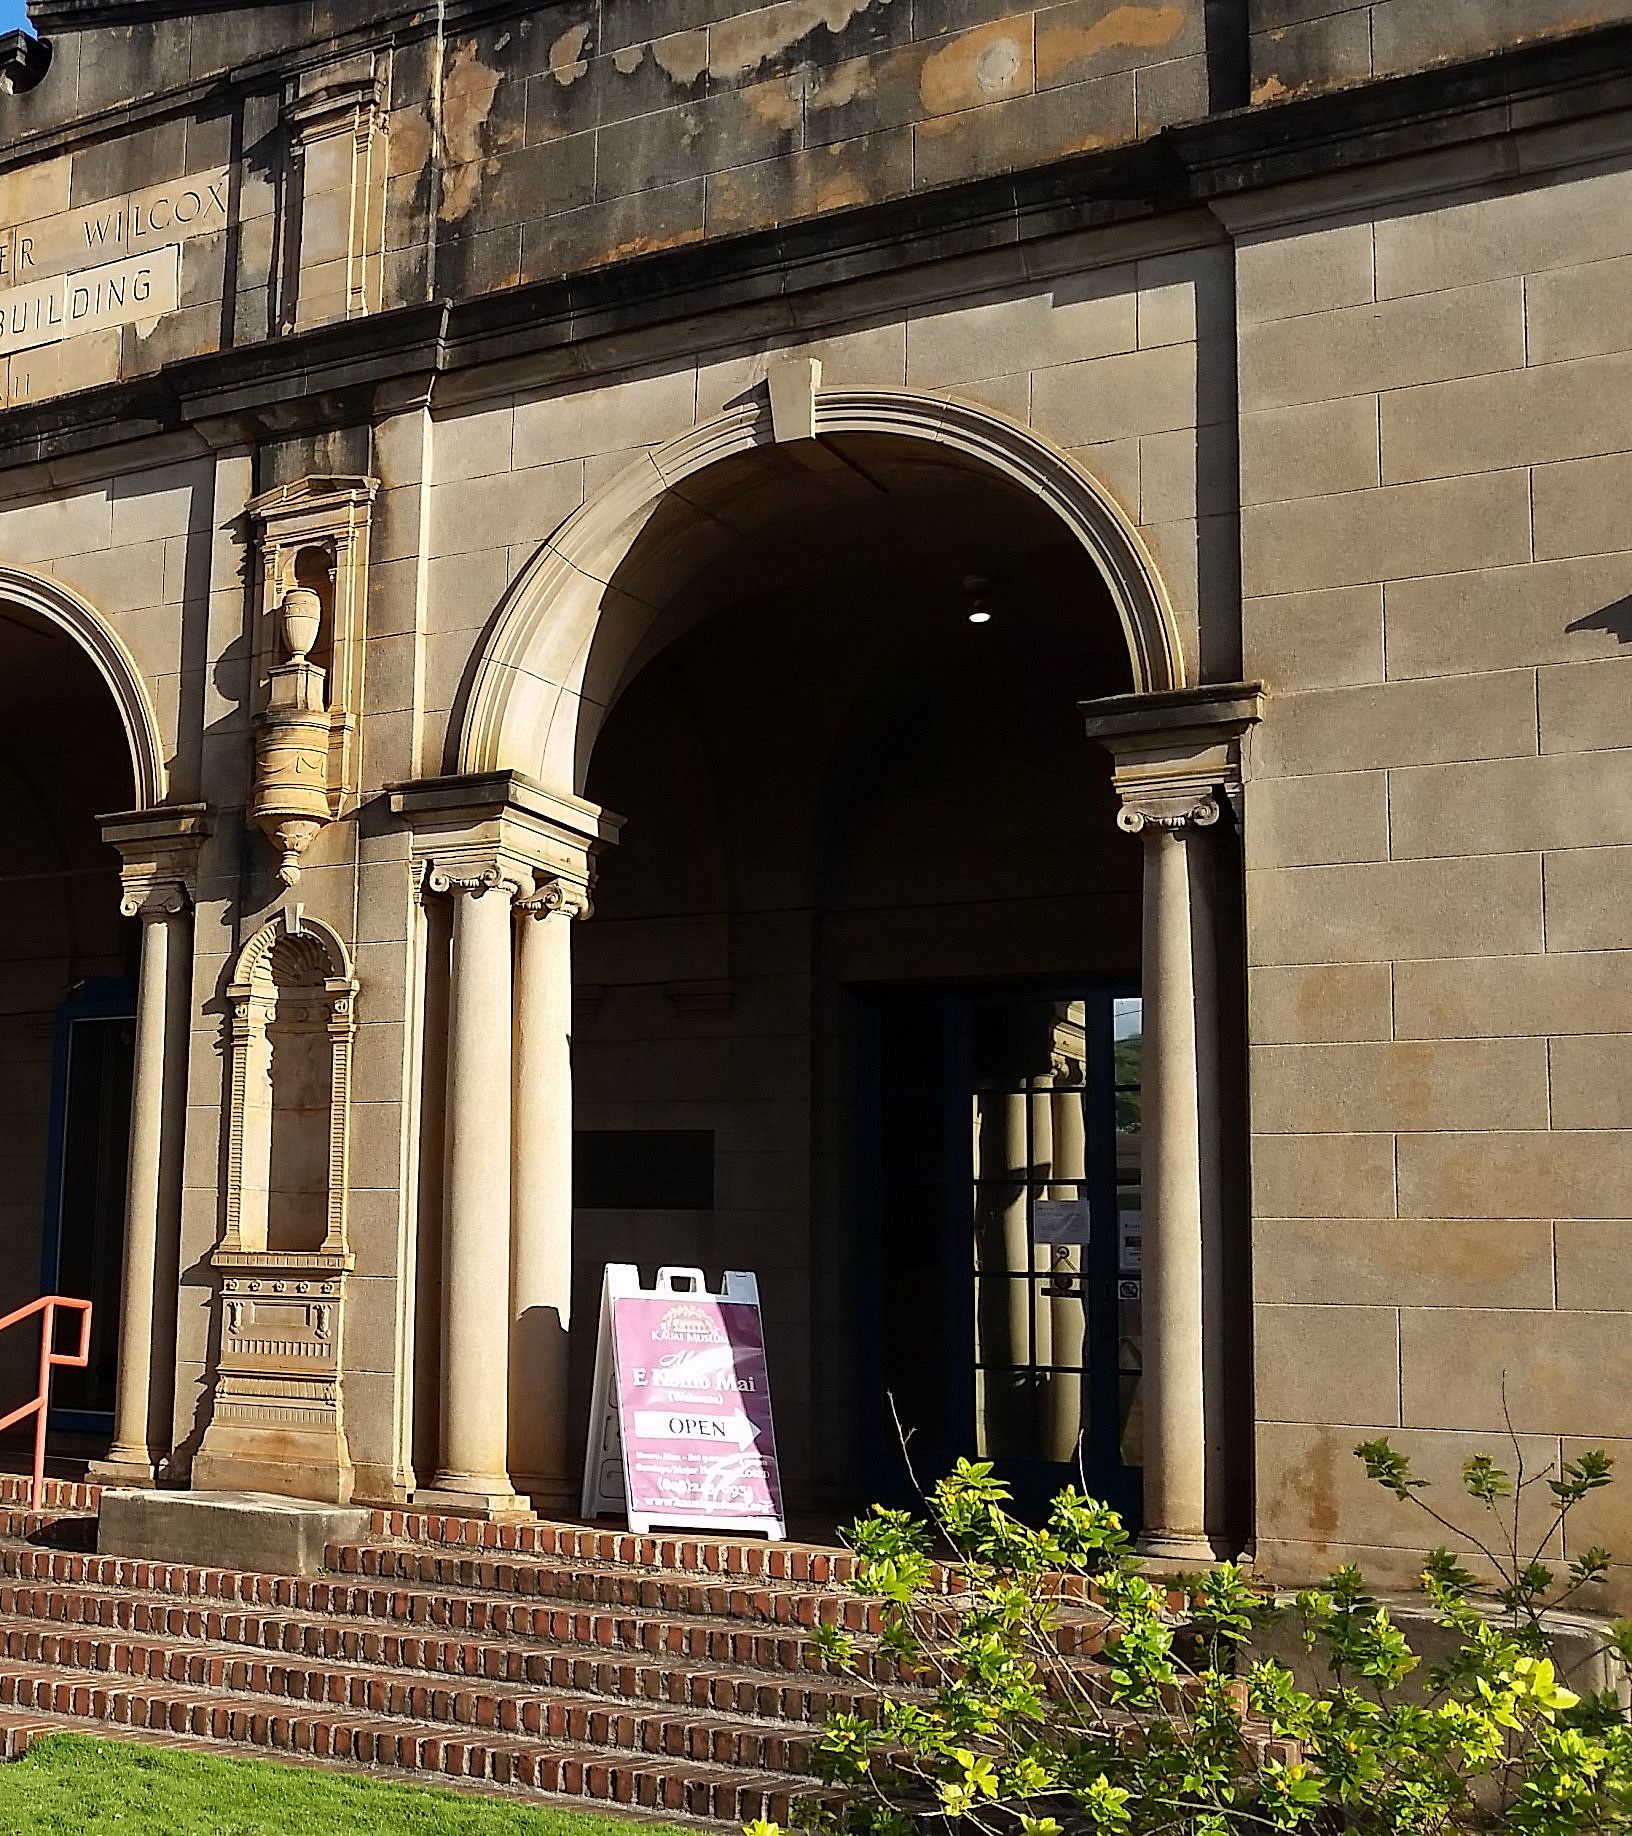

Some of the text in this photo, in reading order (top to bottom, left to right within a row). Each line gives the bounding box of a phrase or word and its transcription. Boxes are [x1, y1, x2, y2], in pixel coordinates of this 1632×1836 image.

[84, 182, 226, 248] WILCOX
[632, 1368, 649, 1386] E
[715, 1374, 756, 1392] Mai
[669, 1417, 726, 1437] OPEN
